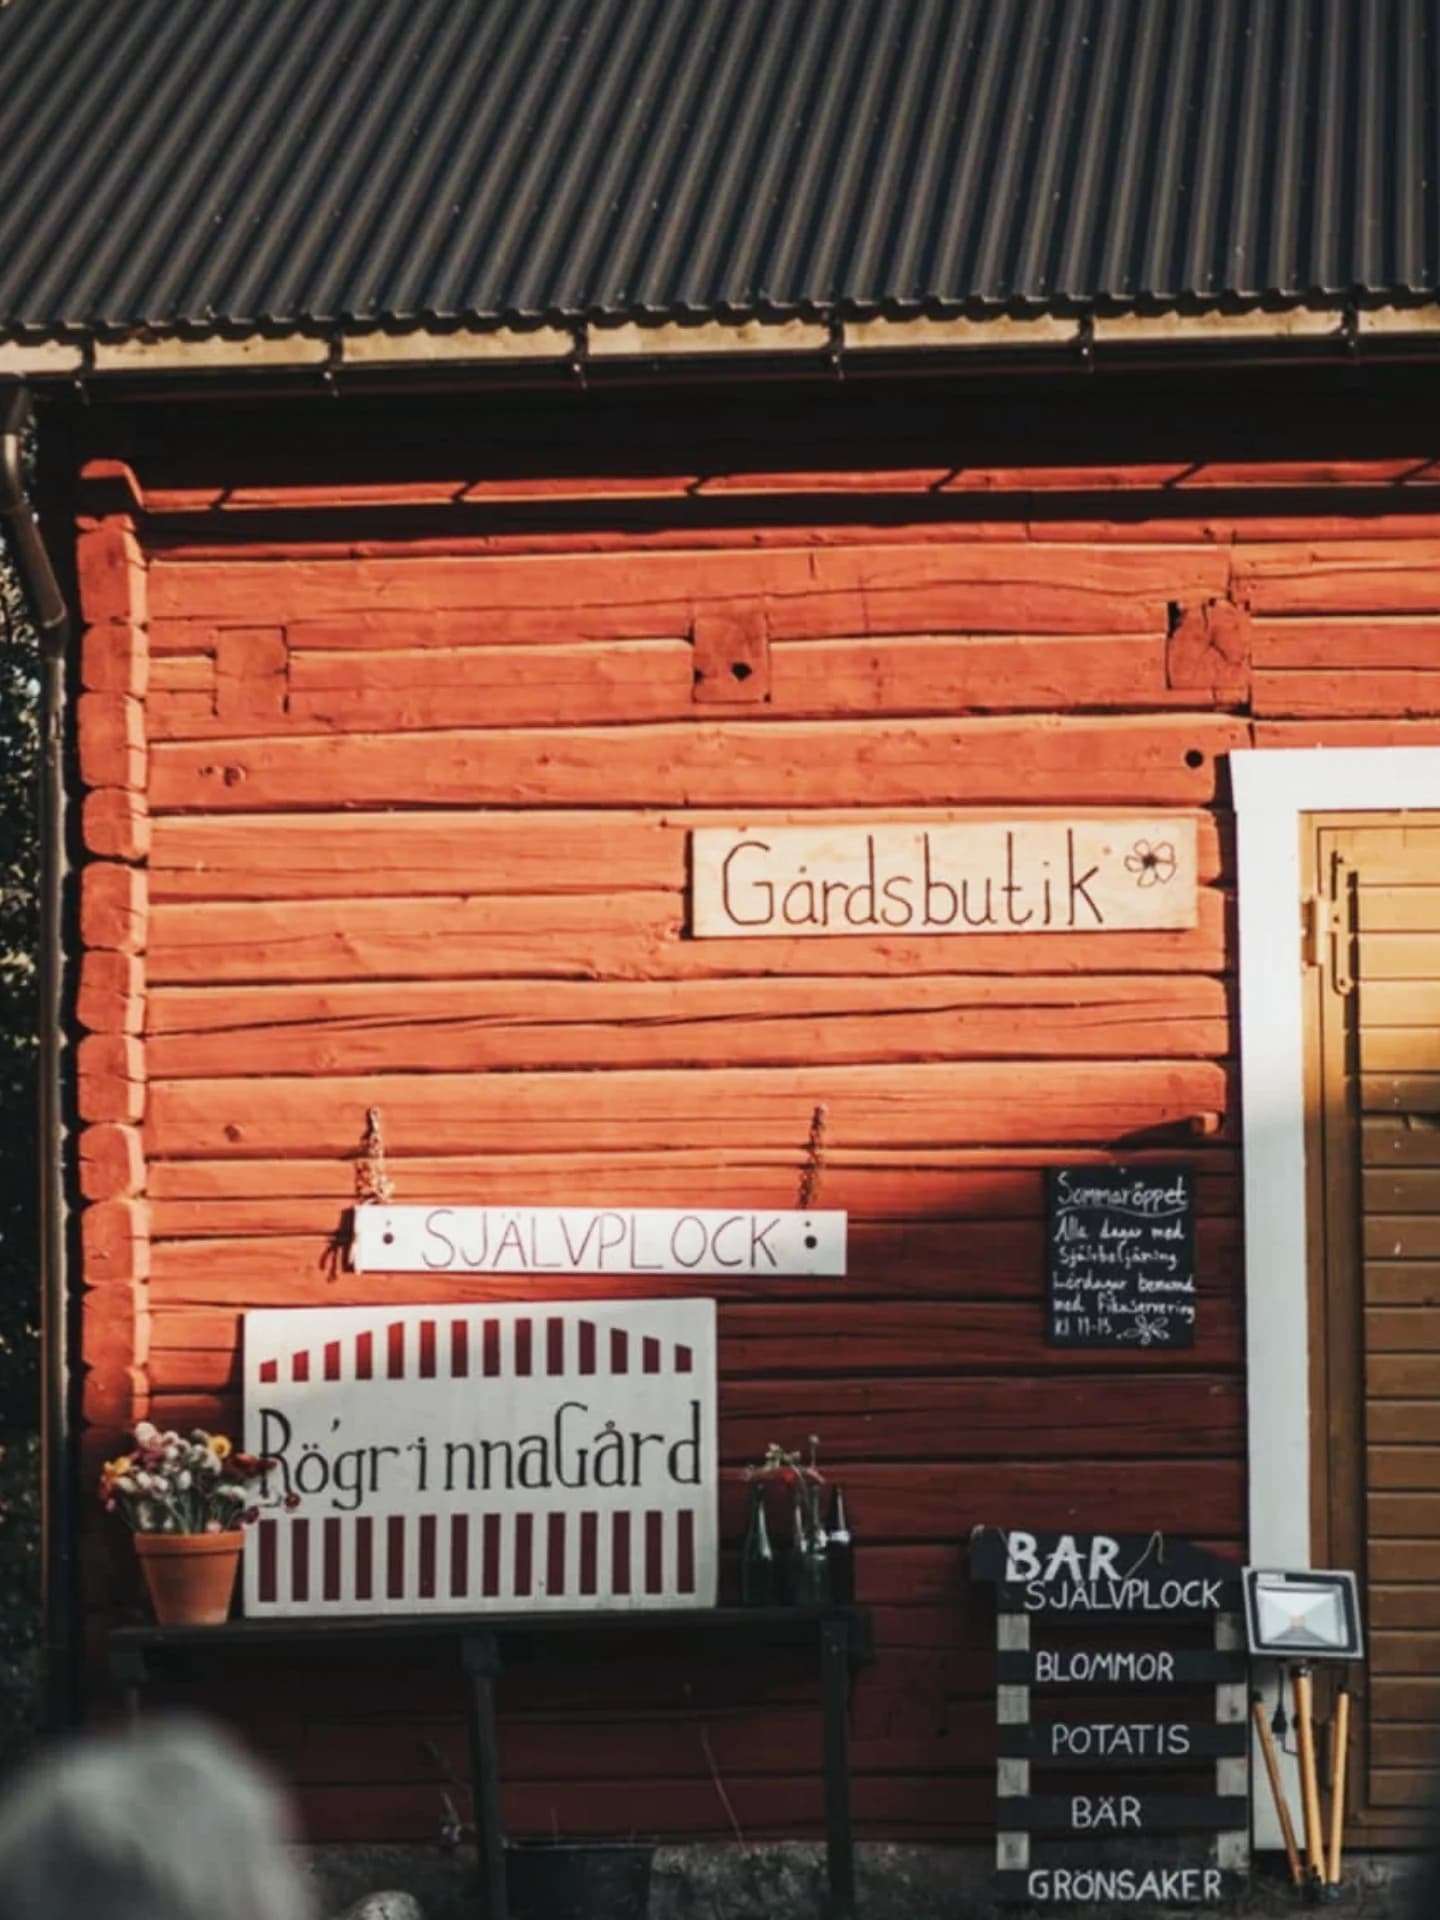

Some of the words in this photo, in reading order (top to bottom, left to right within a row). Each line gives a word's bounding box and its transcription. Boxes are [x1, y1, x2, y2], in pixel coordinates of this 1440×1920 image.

[722, 828, 1104, 927] Gårdsbutik
[1056, 1170, 1188, 1213] Sommaröppet
[421, 1209, 781, 1268] SJÄLVPLOCK
[1151, 1218, 1185, 1239] med
[1053, 1292, 1085, 1312] med
[1035, 1650, 1175, 1682] BLOMMOR
[1051, 1723, 1191, 1756] POTATIS
[1071, 1795, 1142, 1830] BÄR
[1027, 1868, 1223, 1901] GRÖNSAKER
